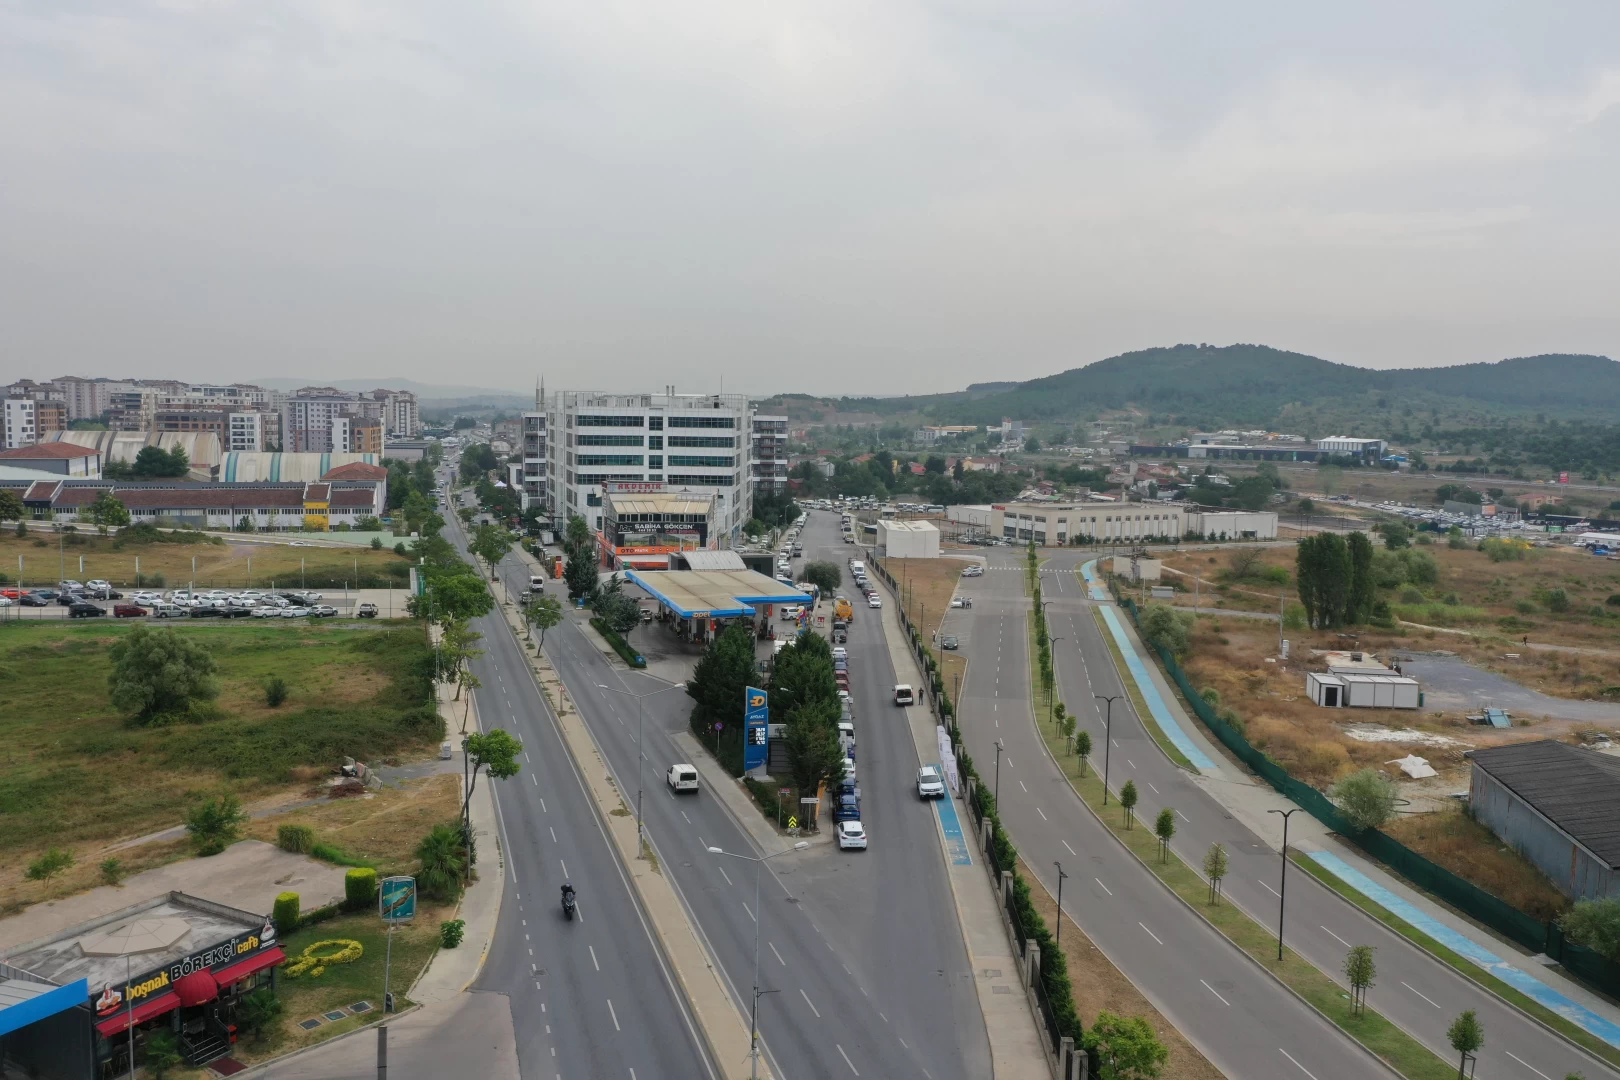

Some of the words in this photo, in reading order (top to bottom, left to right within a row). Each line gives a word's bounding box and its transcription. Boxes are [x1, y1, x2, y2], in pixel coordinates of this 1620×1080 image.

[692, 611, 711, 619] opet
[125, 971, 170, 1001] boşnak
[170, 938, 237, 982] BÖREKÇİ
[236, 936, 260, 954] cafe
